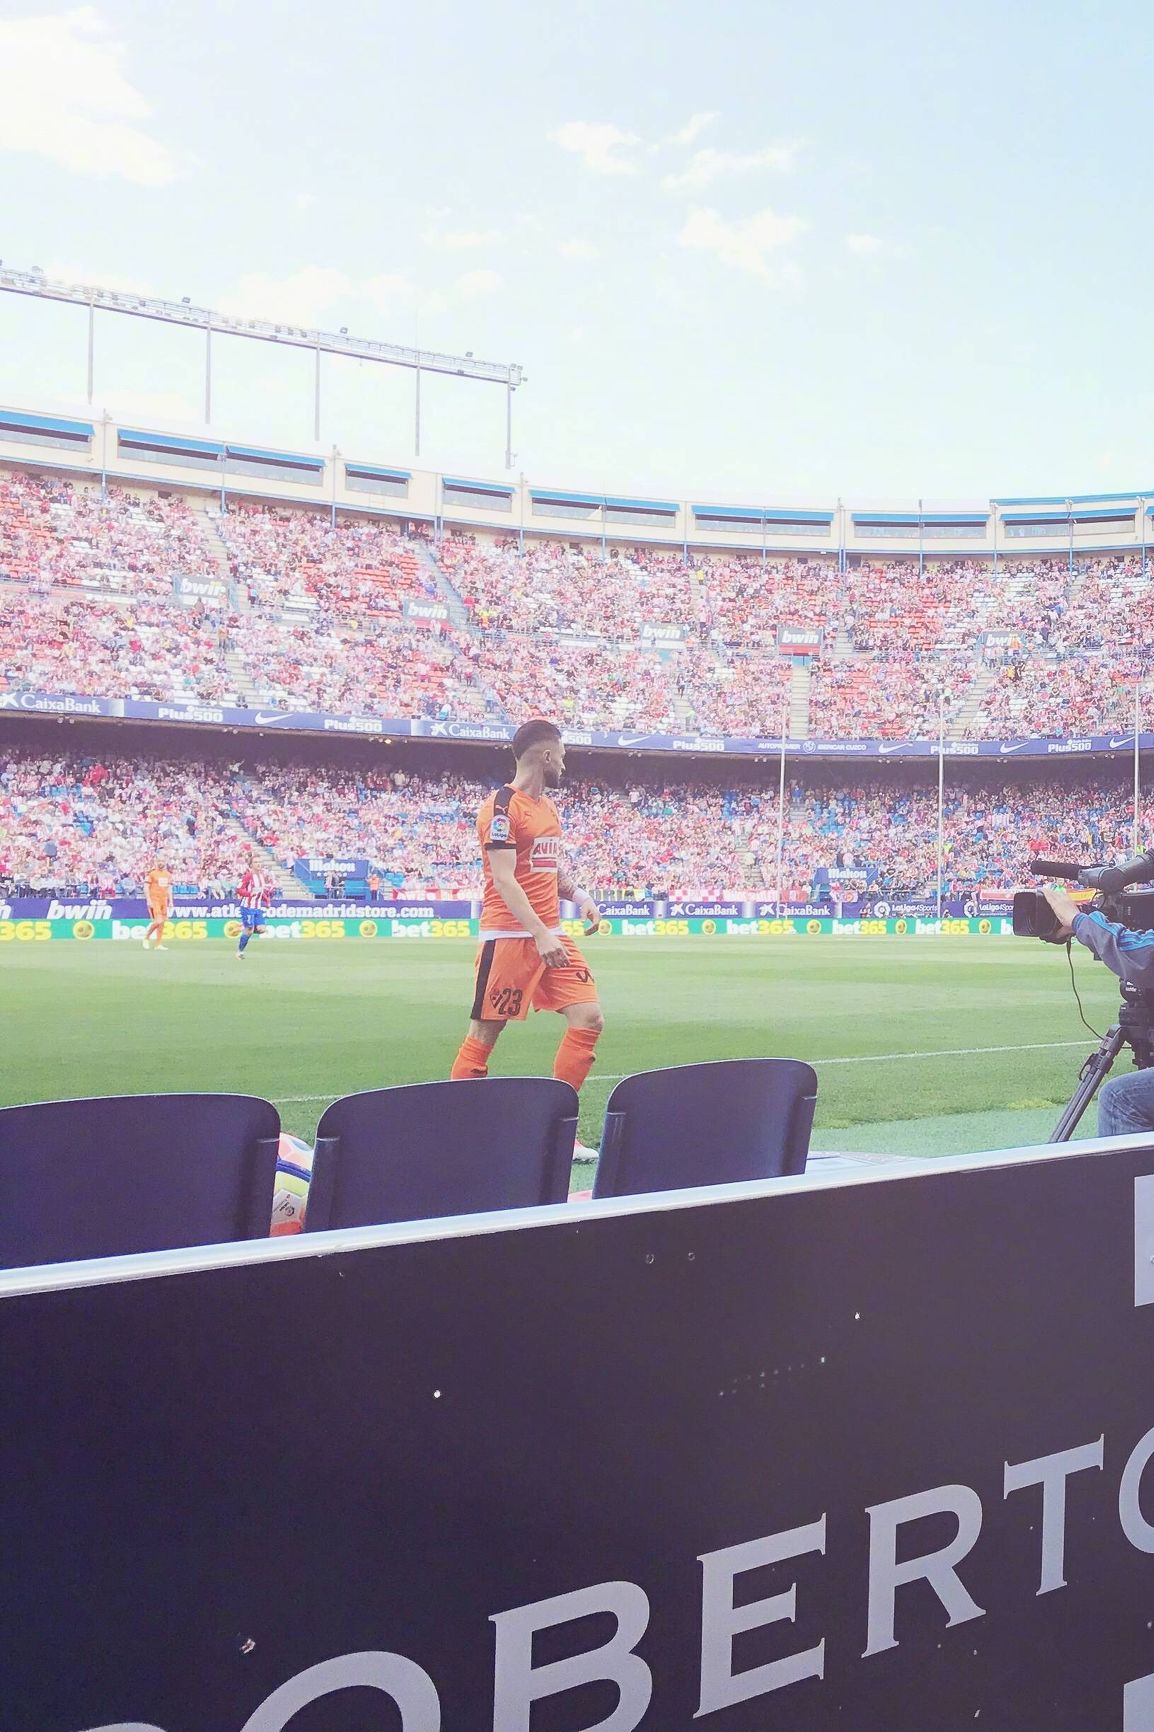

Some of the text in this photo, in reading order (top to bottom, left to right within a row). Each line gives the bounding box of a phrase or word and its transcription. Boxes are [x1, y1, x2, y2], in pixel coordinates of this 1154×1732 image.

[181, 578, 225, 596] bwin
[408, 603, 448, 619] bwin
[643, 626, 681, 639] bwin
[783, 631, 818, 643] bwin
[986, 634, 1021, 648] bwi
[20, 692, 102, 713] CaixaBank
[158, 708, 224, 722] Plus500
[324, 719, 383, 732] Plus500
[448, 723, 511, 740] CaixaBank
[673, 740, 725, 751] Plus500
[930, 743, 979, 755] Plus500
[1047, 741, 1092, 753] Plus500
[47, 900, 113, 920] bwin
[598, 904, 650, 917] CaixaBank
[685, 904, 738, 917] CaixaBank
[391, 920, 471, 937] bet365
[621, 920, 689, 936] bet365
[727, 919, 794, 935] bet365
[832, 920, 887, 935] bet365
[915, 920, 970, 935] bet365
[498, 988, 523, 1017] 23
